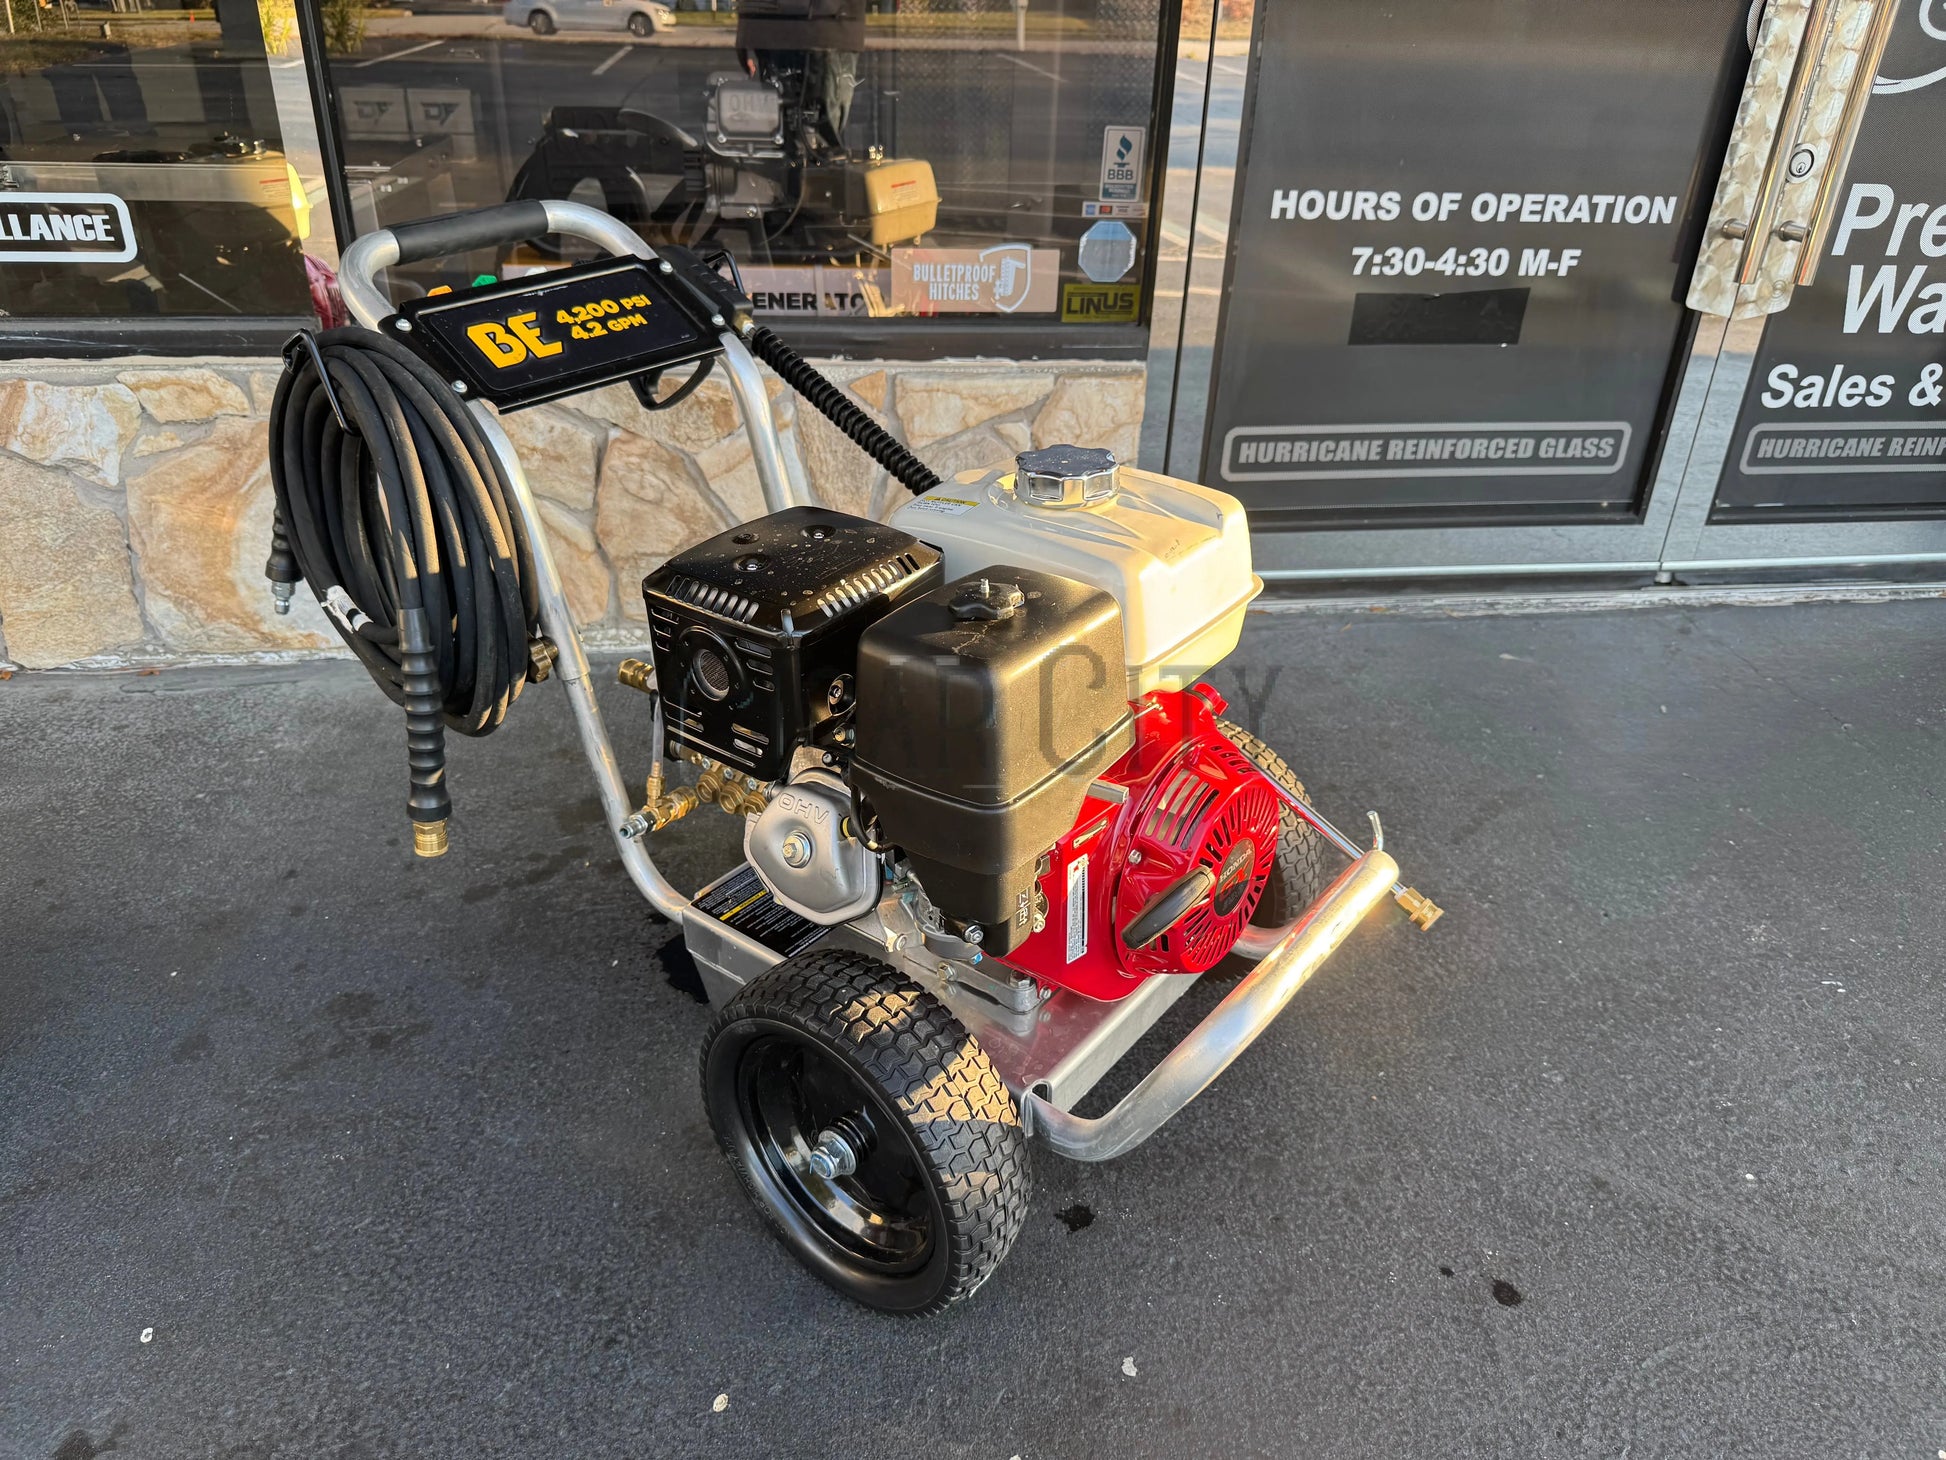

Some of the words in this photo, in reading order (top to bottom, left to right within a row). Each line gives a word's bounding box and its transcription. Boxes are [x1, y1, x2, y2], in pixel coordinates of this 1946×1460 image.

[1107, 169, 1133, 180] BBB
[1270, 189, 1401, 220] HOURS
[1412, 192, 1462, 222] OF
[1470, 193, 1677, 224] OPERATION
[913, 263, 996, 282] BULLETPROOF
[1351, 246, 1510, 277] 7:30-4:30
[1518, 249, 1582, 277] M-F
[929, 282, 980, 300] HITCHES
[1067, 292, 1134, 315] LINUS
[556, 297, 620, 325] 4,200
[620, 293, 653, 311] PSI
[466, 311, 563, 369] BE
[570, 320, 608, 341] 4.2
[607, 312, 649, 332] GPM
[1761, 363, 1896, 409] Sales
[1908, 362, 1943, 407] &
[1238, 438, 1382, 464] HURRICANE
[1386, 438, 1534, 461] REINFORCED
[1538, 437, 1615, 459] GLASS
[1757, 437, 1887, 459] HURRICANE
[779, 793, 829, 824] OHV
[1219, 848, 1252, 883] HONDA
